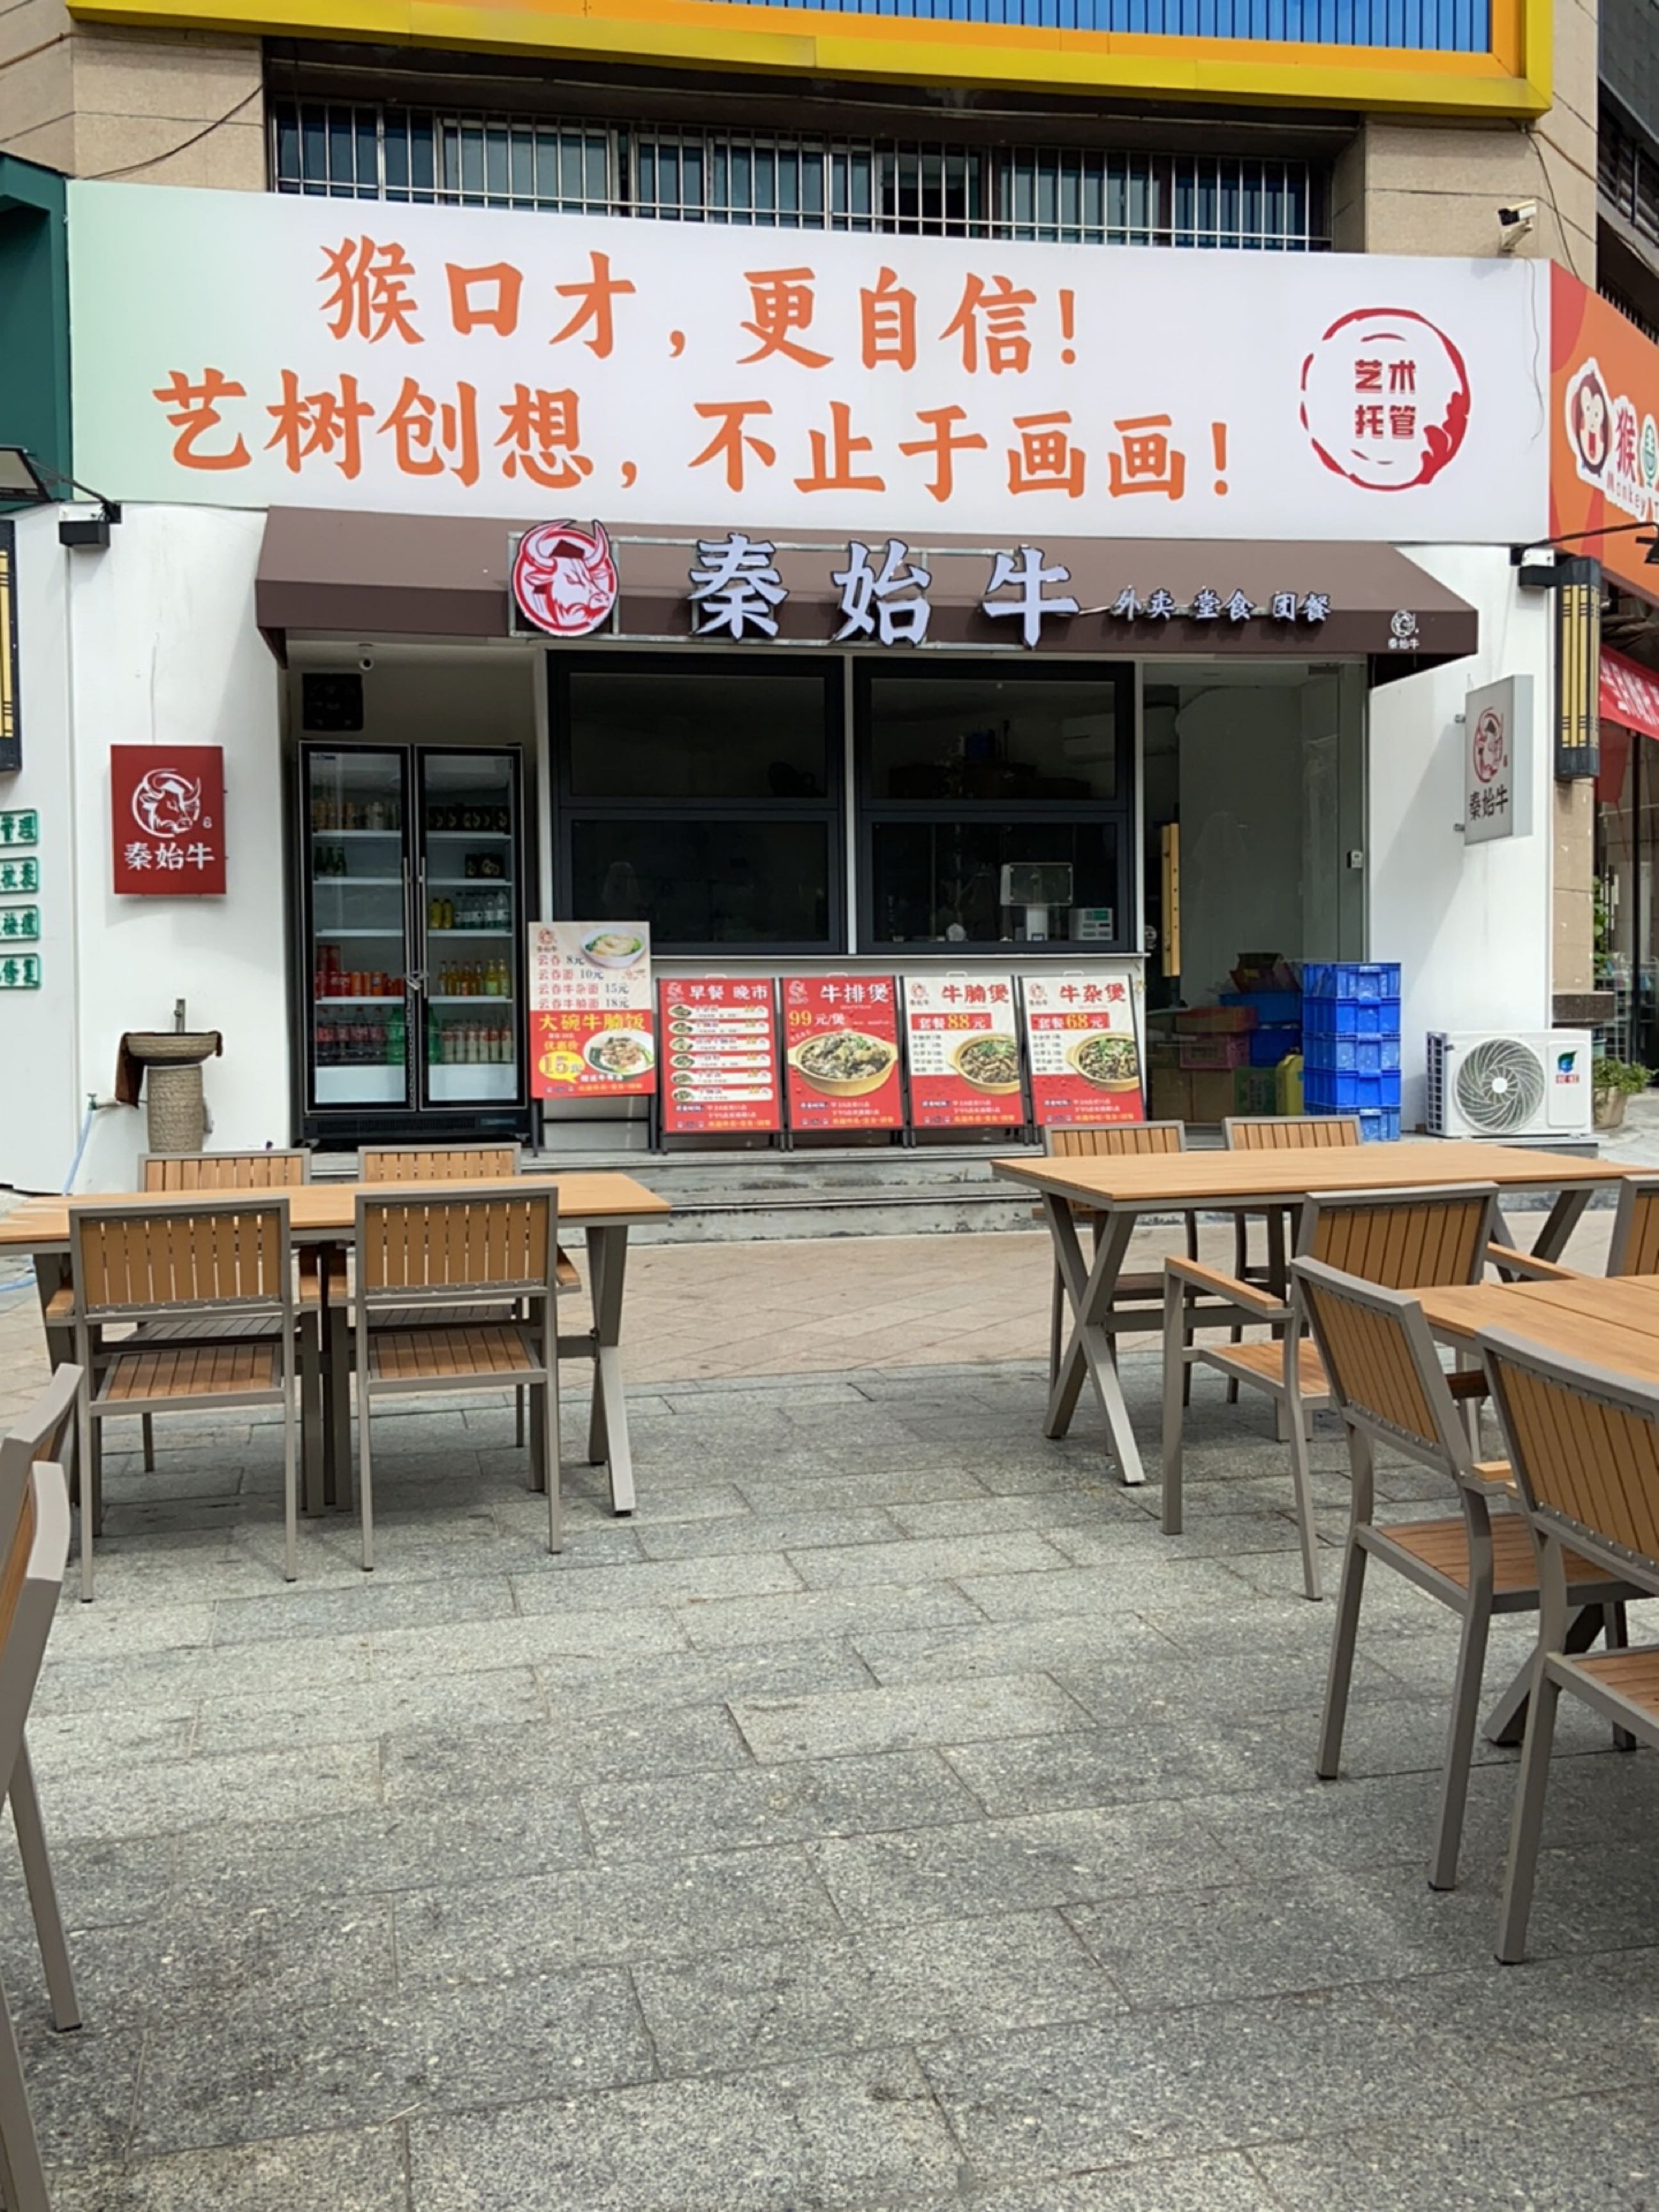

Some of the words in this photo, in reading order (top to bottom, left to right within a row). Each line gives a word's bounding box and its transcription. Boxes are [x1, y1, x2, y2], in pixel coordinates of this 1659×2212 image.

[1354, 358, 1416, 394] 艺术
[1354, 404, 1416, 440] 托管
[688, 533, 1079, 650] 秦始牛
[1112, 587, 1176, 621] 外卖
[1194, 588, 1254, 622] 堂食
[1271, 591, 1332, 623] 团餐
[1470, 784, 1509, 822] 秦始牛
[124, 841, 216, 871] 秦始牛
[580, 968, 604, 980] 10元
[605, 983, 630, 995] 15元
[689, 984, 725, 1000] 早餐
[733, 984, 769, 1000] 晚市
[821, 982, 890, 1004] 牛排煲
[942, 983, 1009, 1004] 牛腩煲
[1060, 982, 1126, 1004] 牛杂煲
[605, 998, 630, 1009] 18元
[538, 1013, 646, 1032] 大碗牛腩饭
